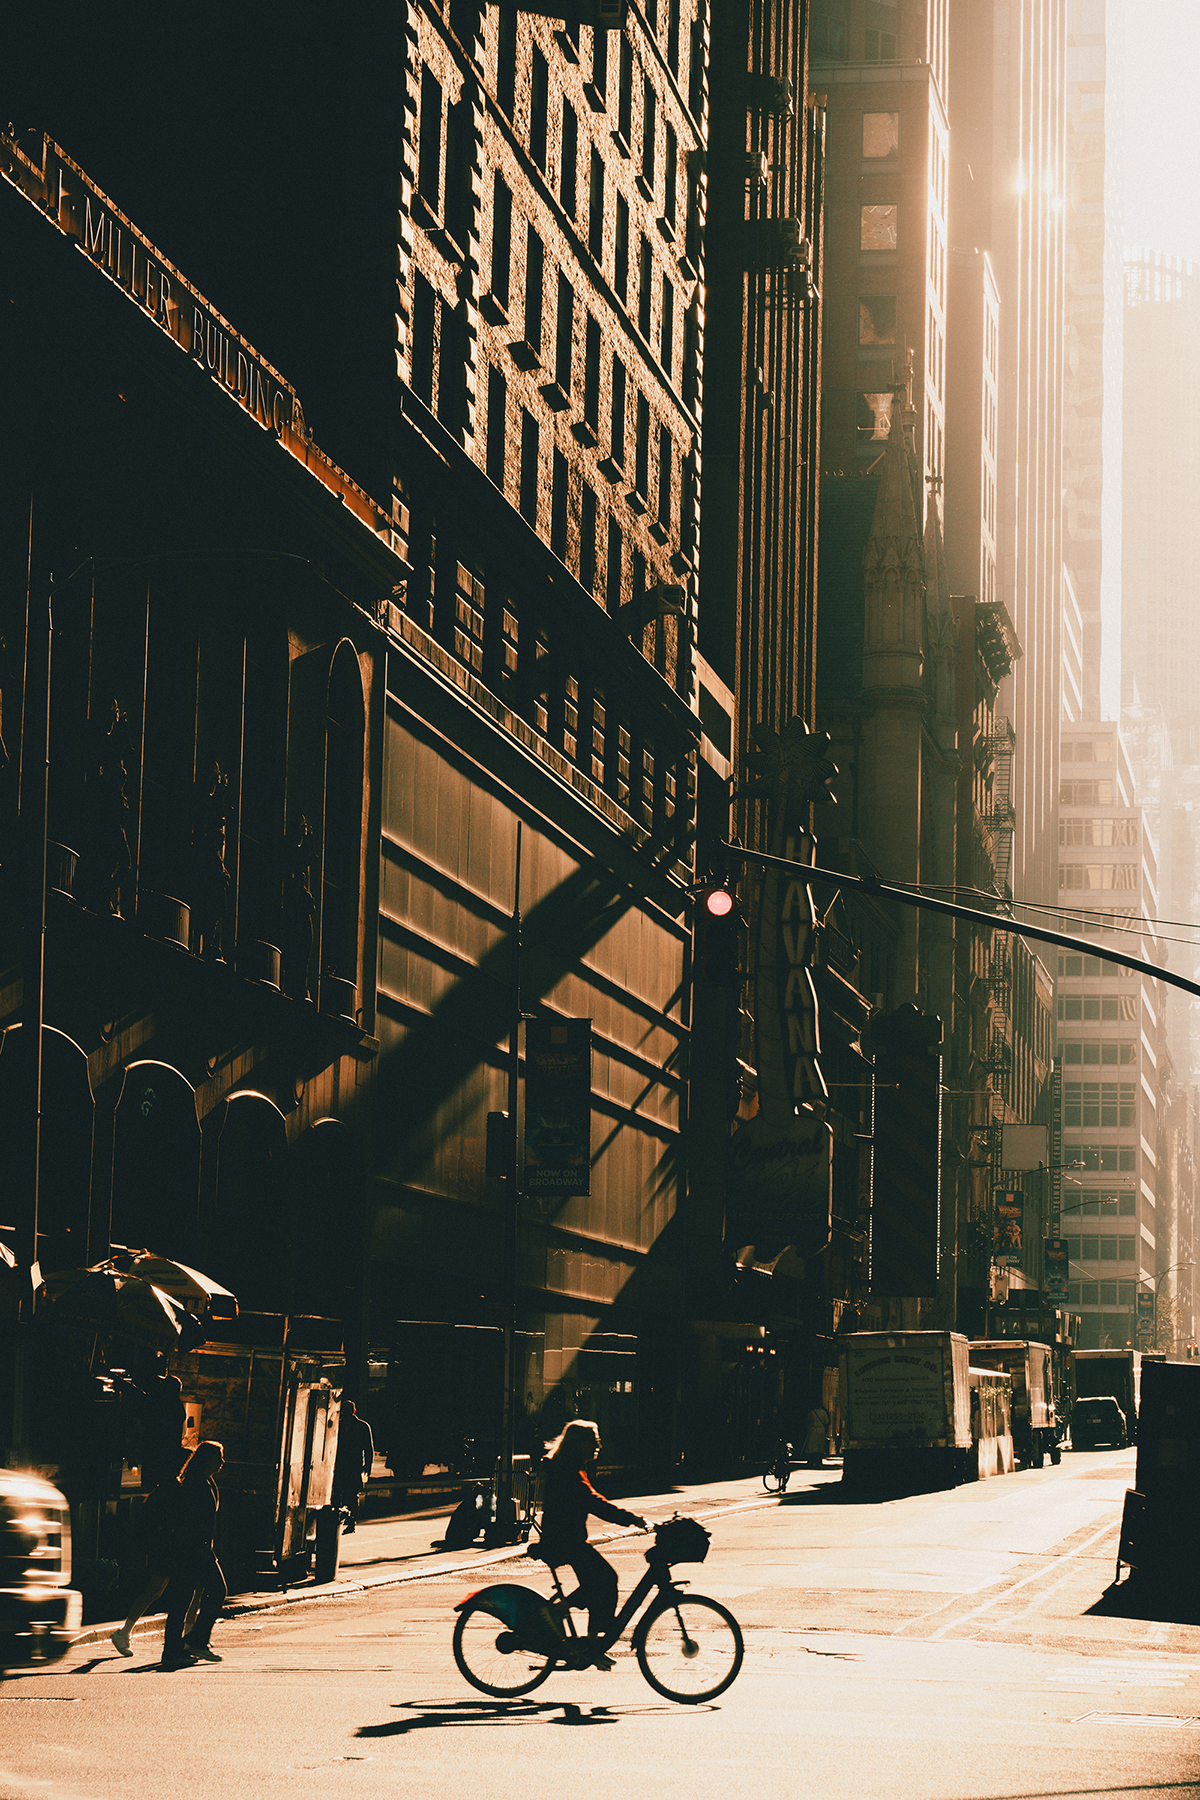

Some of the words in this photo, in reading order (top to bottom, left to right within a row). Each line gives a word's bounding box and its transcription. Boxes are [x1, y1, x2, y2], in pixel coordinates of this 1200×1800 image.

[83, 194, 173, 331] MILLER
[191, 304, 286, 438] BUILDING
[781, 834, 821, 1099] HAVANA
[532, 1051, 574, 1066] BACK
[547, 1063, 585, 1077] FUTURE
[733, 1127, 825, 1172] Central
[1053, 1130, 1061, 1161] CENTER
[528, 1178, 585, 1186] BROADWAY
[536, 1169, 561, 1178] NOW
[562, 1169, 578, 1178] ON
[1053, 1168, 1061, 1214] STEINBERG
